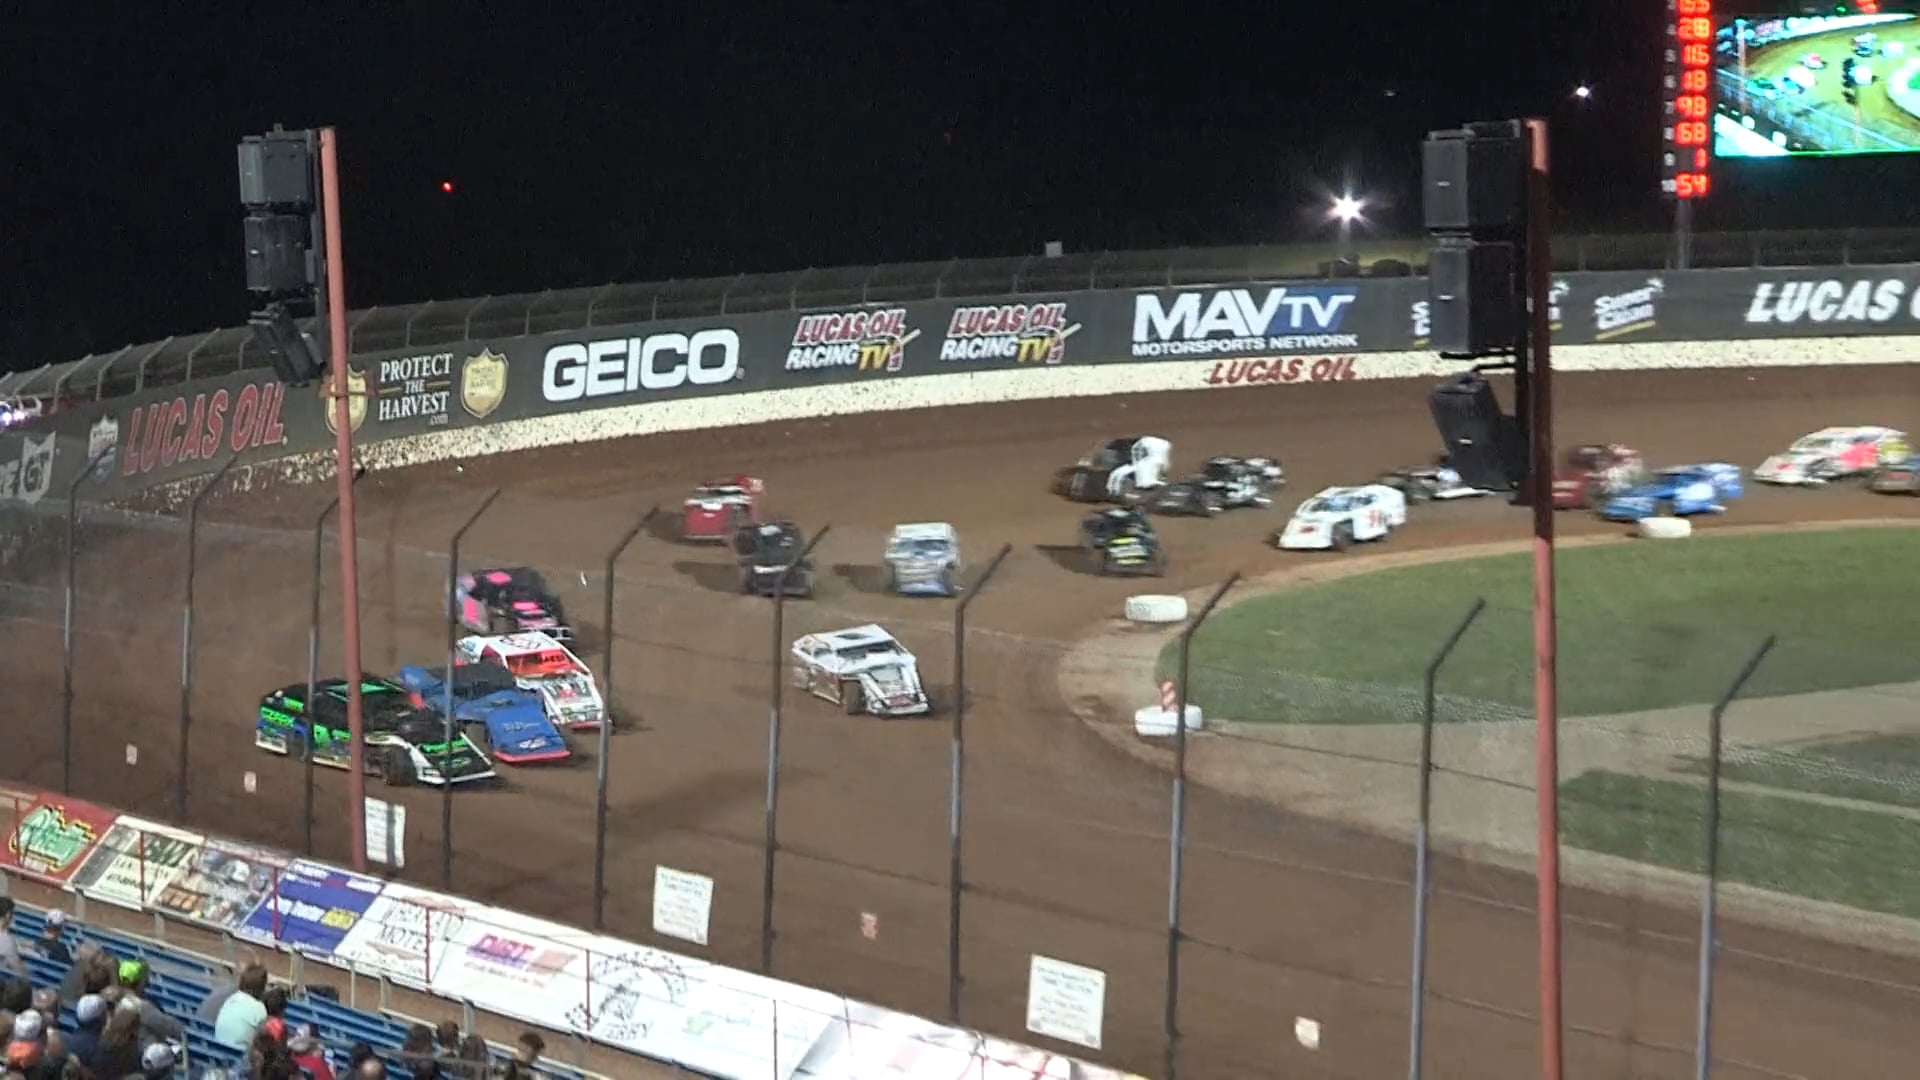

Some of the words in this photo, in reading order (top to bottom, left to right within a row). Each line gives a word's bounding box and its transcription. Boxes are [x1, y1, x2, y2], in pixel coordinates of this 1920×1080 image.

[1676, 96, 1707, 118] 98
[1676, 121, 1707, 145] 68
[1695, 147, 1707, 169] 1
[1676, 173, 1707, 197] 54
[1744, 279, 1906, 322] LUCAS
[793, 312, 865, 347] LUCAS
[869, 308, 908, 337] OIL
[948, 305, 1025, 336] LUCAS
[1028, 303, 1068, 332] OIL
[786, 342, 859, 371] RACING
[940, 335, 1019, 362] RACING
[1133, 338, 1265, 357] MOTORSPORTS
[1269, 334, 1358, 351] NETWORK
[381, 353, 453, 382] PROTECT
[542, 328, 740, 402] GEICO
[1207, 358, 1304, 385] LUCAS
[1311, 357, 1358, 382] OIL
[405, 379, 425, 394] THE
[379, 392, 450, 421] HARVEST
[123, 388, 228, 476] LUCAS
[231, 380, 285, 452] OIL
